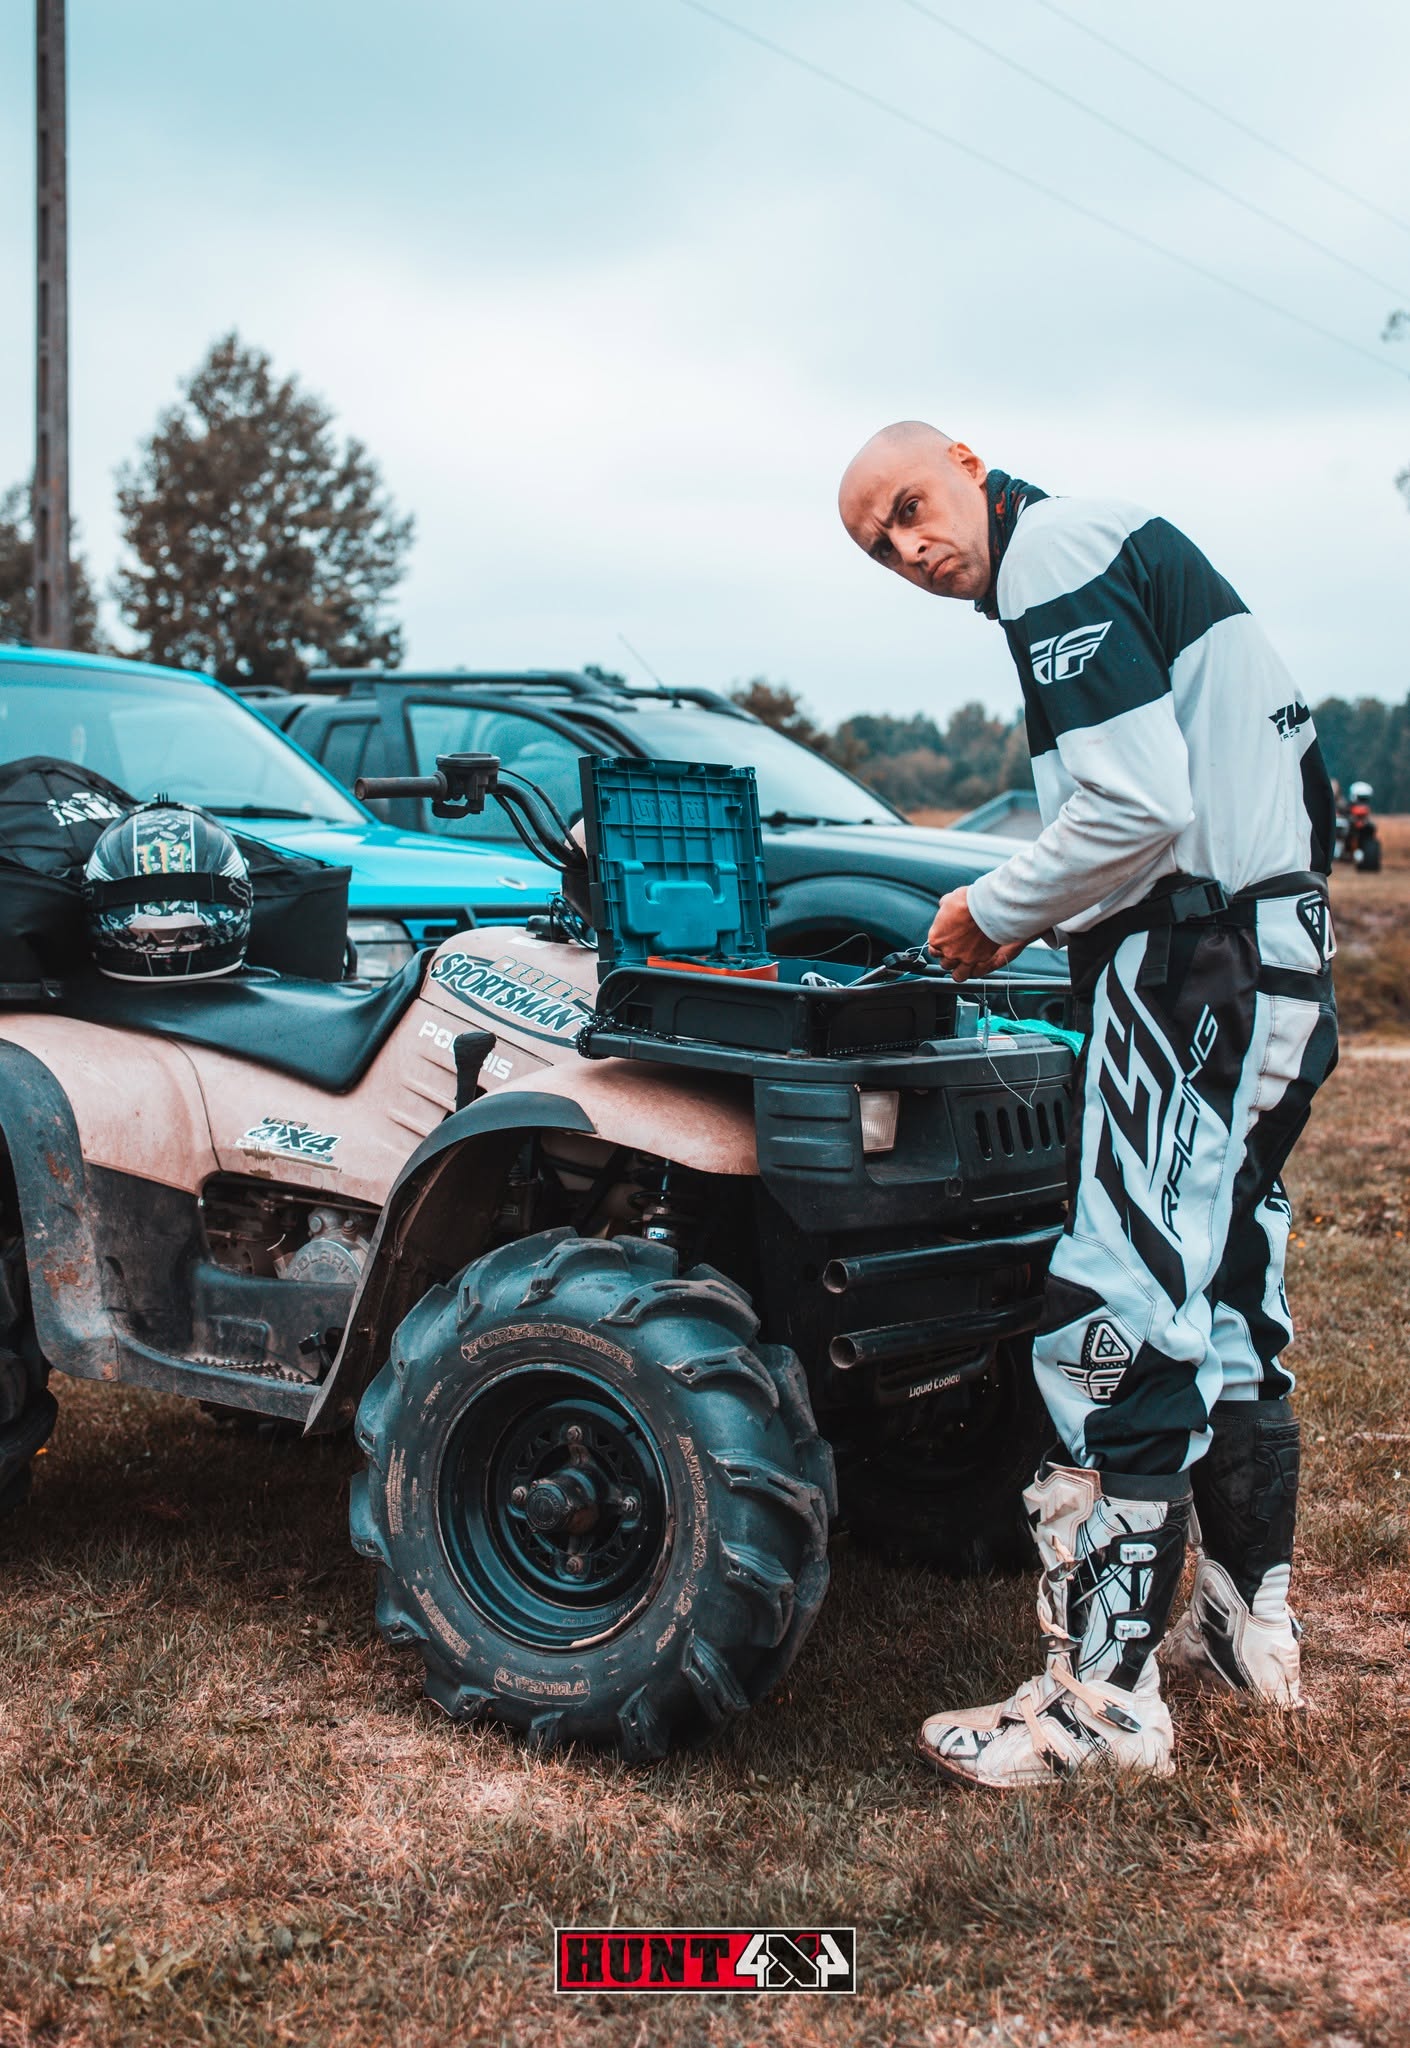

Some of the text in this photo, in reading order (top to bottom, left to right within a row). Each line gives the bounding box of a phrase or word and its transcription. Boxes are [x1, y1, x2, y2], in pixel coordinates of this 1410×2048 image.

[430, 952, 588, 1034] SPORTSMAN
[489, 956, 591, 1004] DESERT
[1160, 1003, 1219, 1243] RACING
[908, 1379, 933, 1398] Liquid
